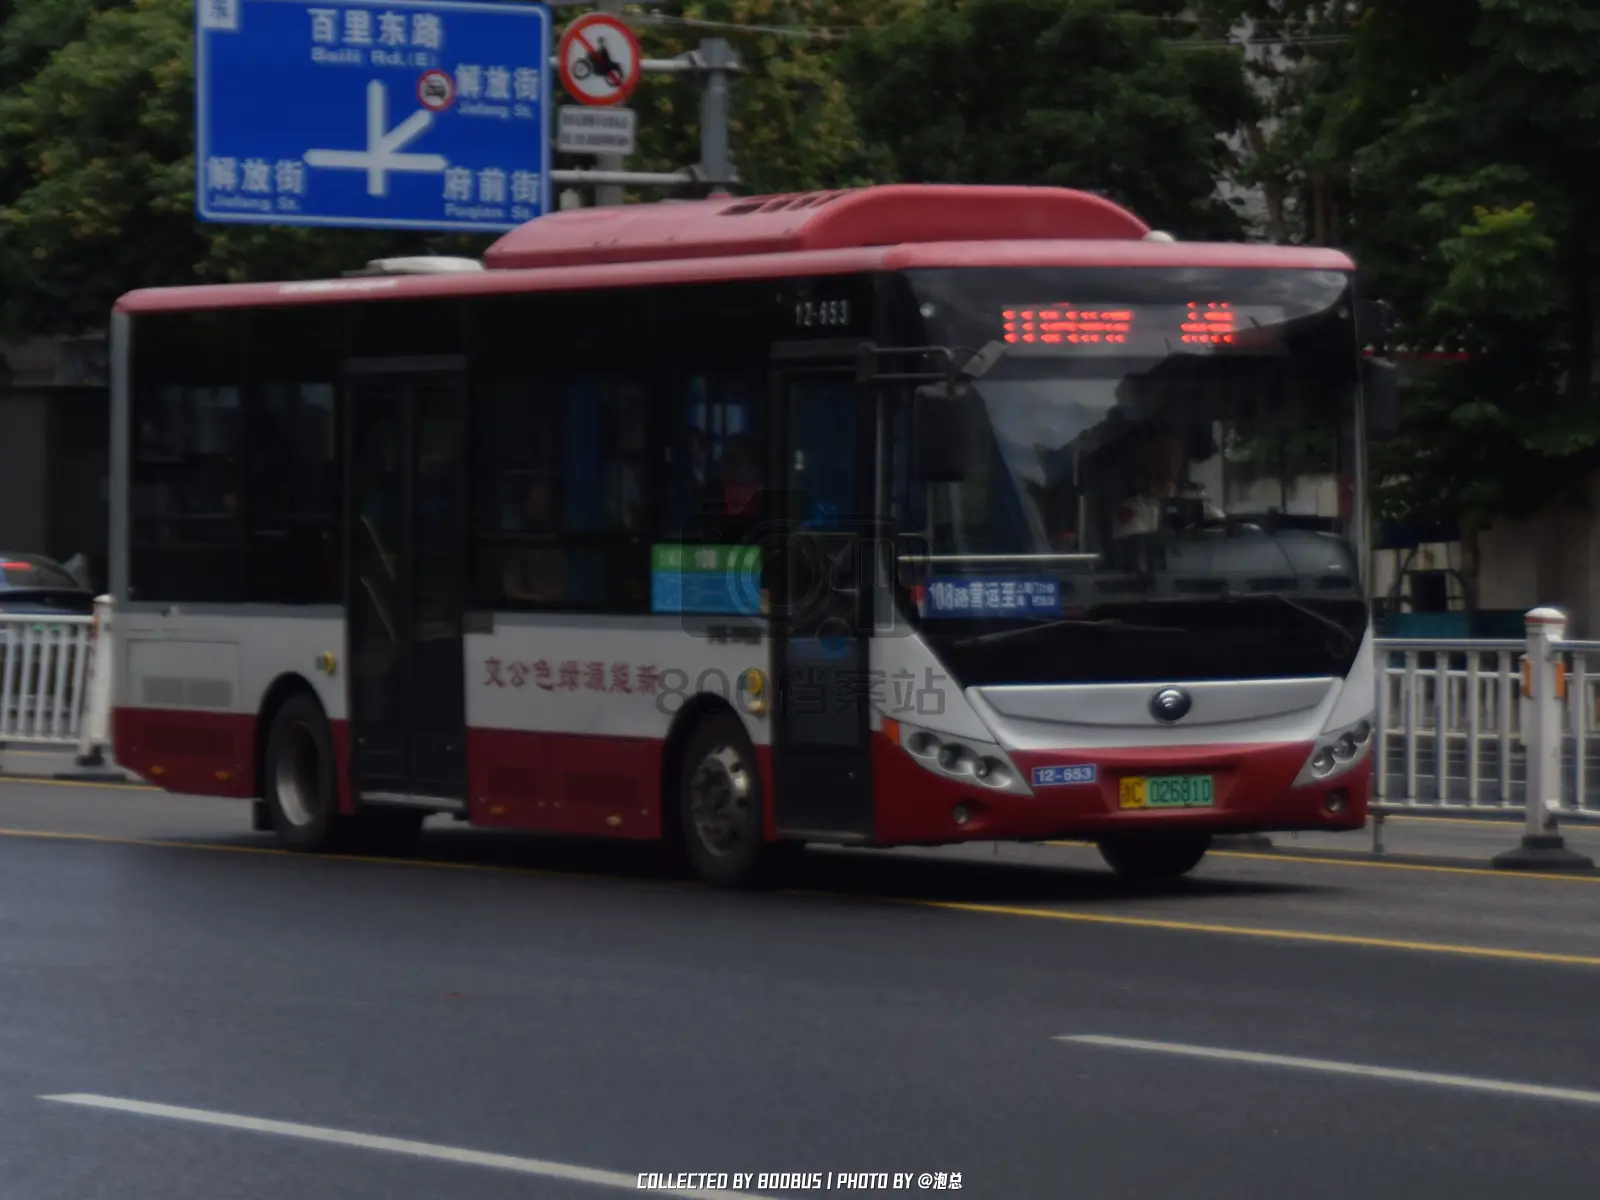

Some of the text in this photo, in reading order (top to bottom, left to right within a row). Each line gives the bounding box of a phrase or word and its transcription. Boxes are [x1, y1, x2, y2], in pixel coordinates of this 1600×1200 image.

[309, 8, 442, 50] 百里东路
[310, 49, 362, 65] Baili
[455, 63, 539, 101] 解放街
[207, 156, 304, 194] 解放街
[442, 168, 539, 205] 府前街
[794, 300, 848, 327] 12-653
[1035, 767, 1092, 783] 12-653
